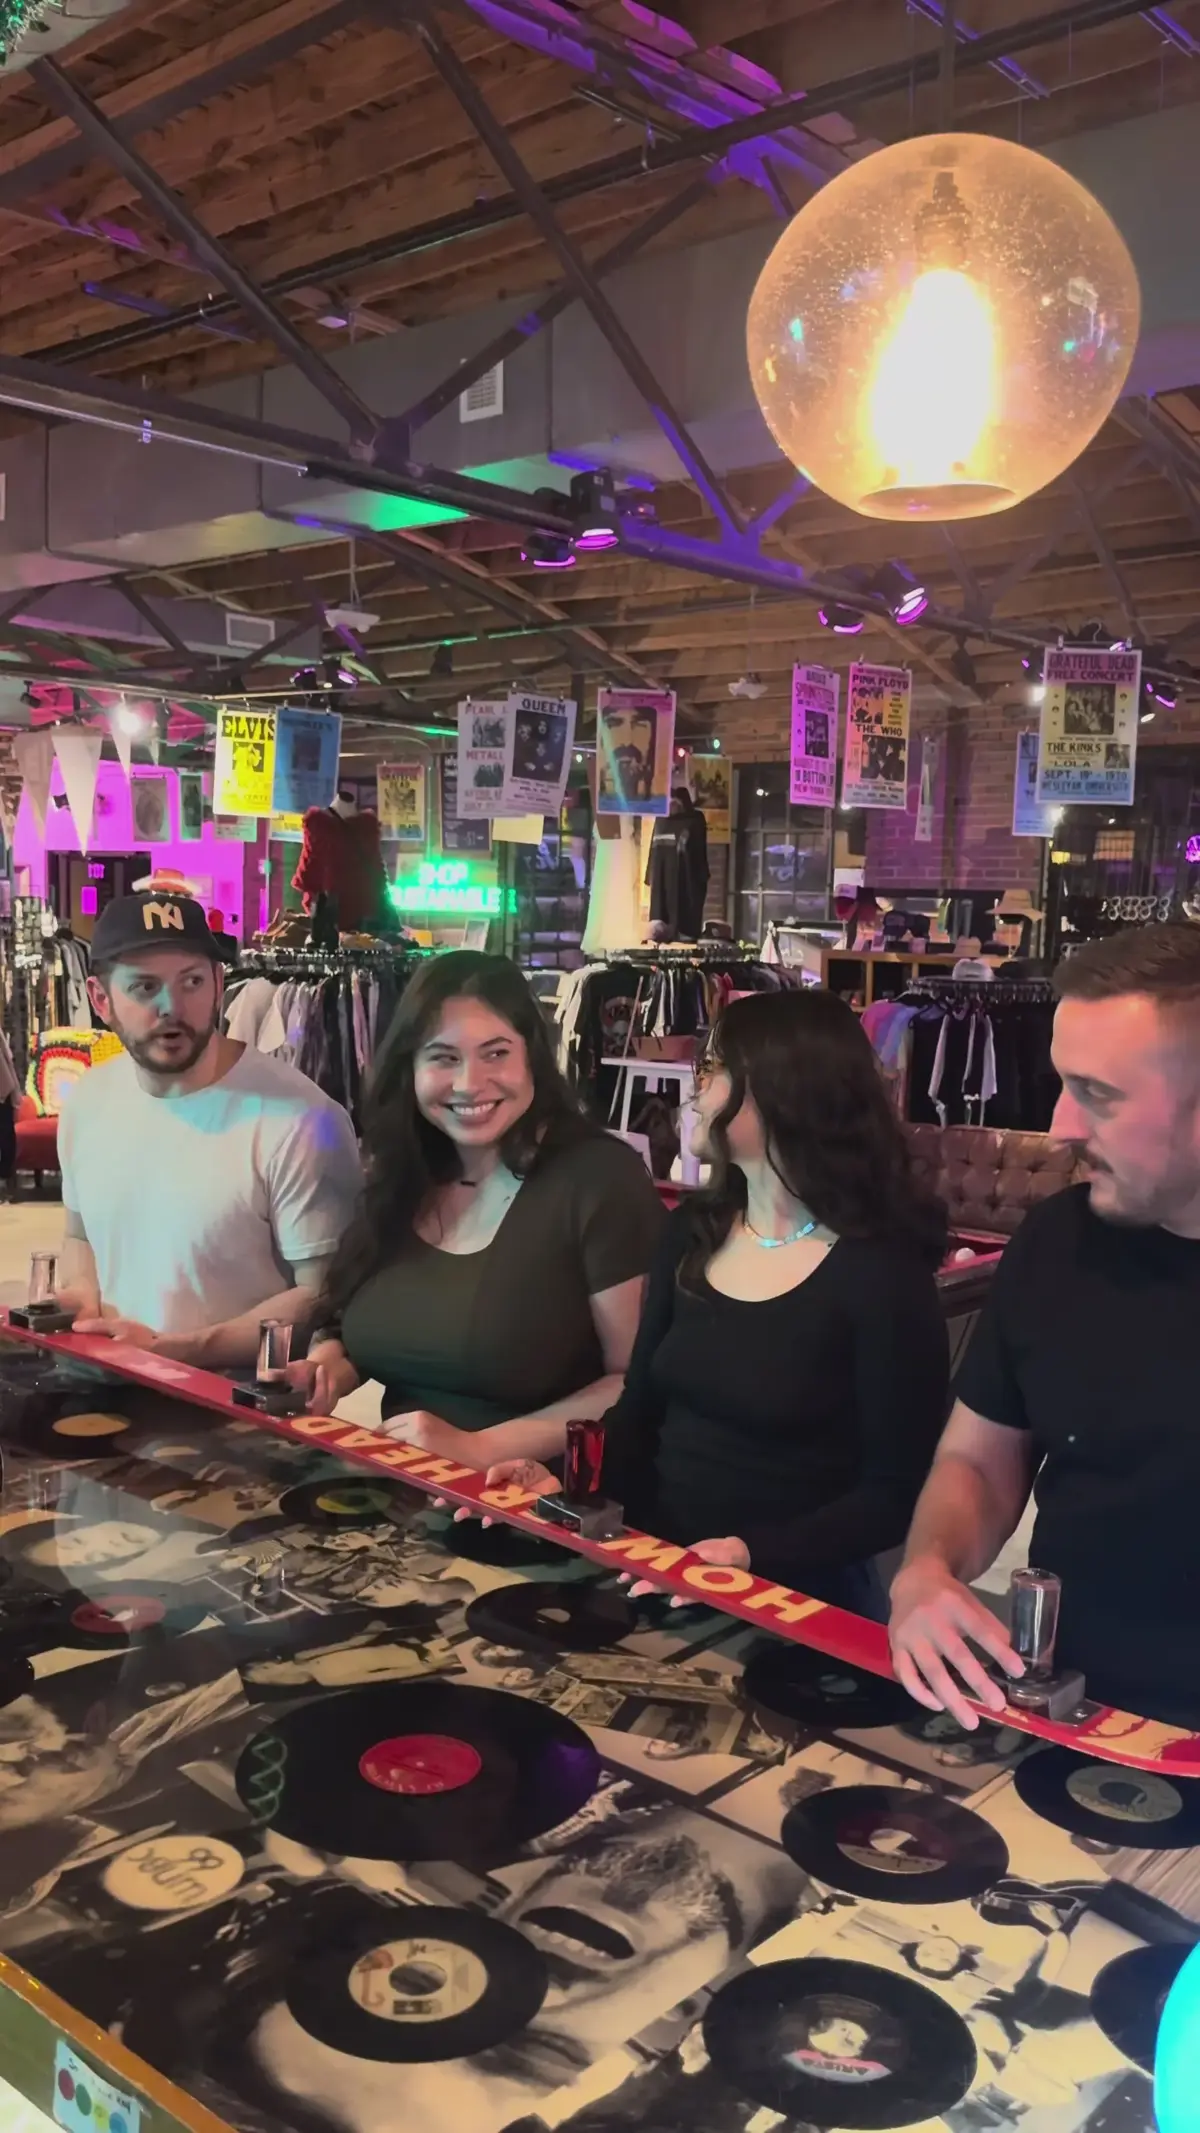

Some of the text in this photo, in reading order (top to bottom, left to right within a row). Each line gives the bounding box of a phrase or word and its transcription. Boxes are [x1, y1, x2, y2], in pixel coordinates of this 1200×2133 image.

[1049, 653, 1137, 670] GRATEFUL DEAD
[852, 674, 909, 690] PINK FLOYD
[1047, 669, 1135, 682] FREE CONCERT
[521, 698, 567, 714] QUEEN
[221, 715, 276, 741] ELVIS
[855, 723, 903, 736] THE WHO
[1047, 742, 1102, 753] THE KINKS
[289, 1415, 479, 1484] HEAD
[800, 2058, 870, 2076] ARISTA
